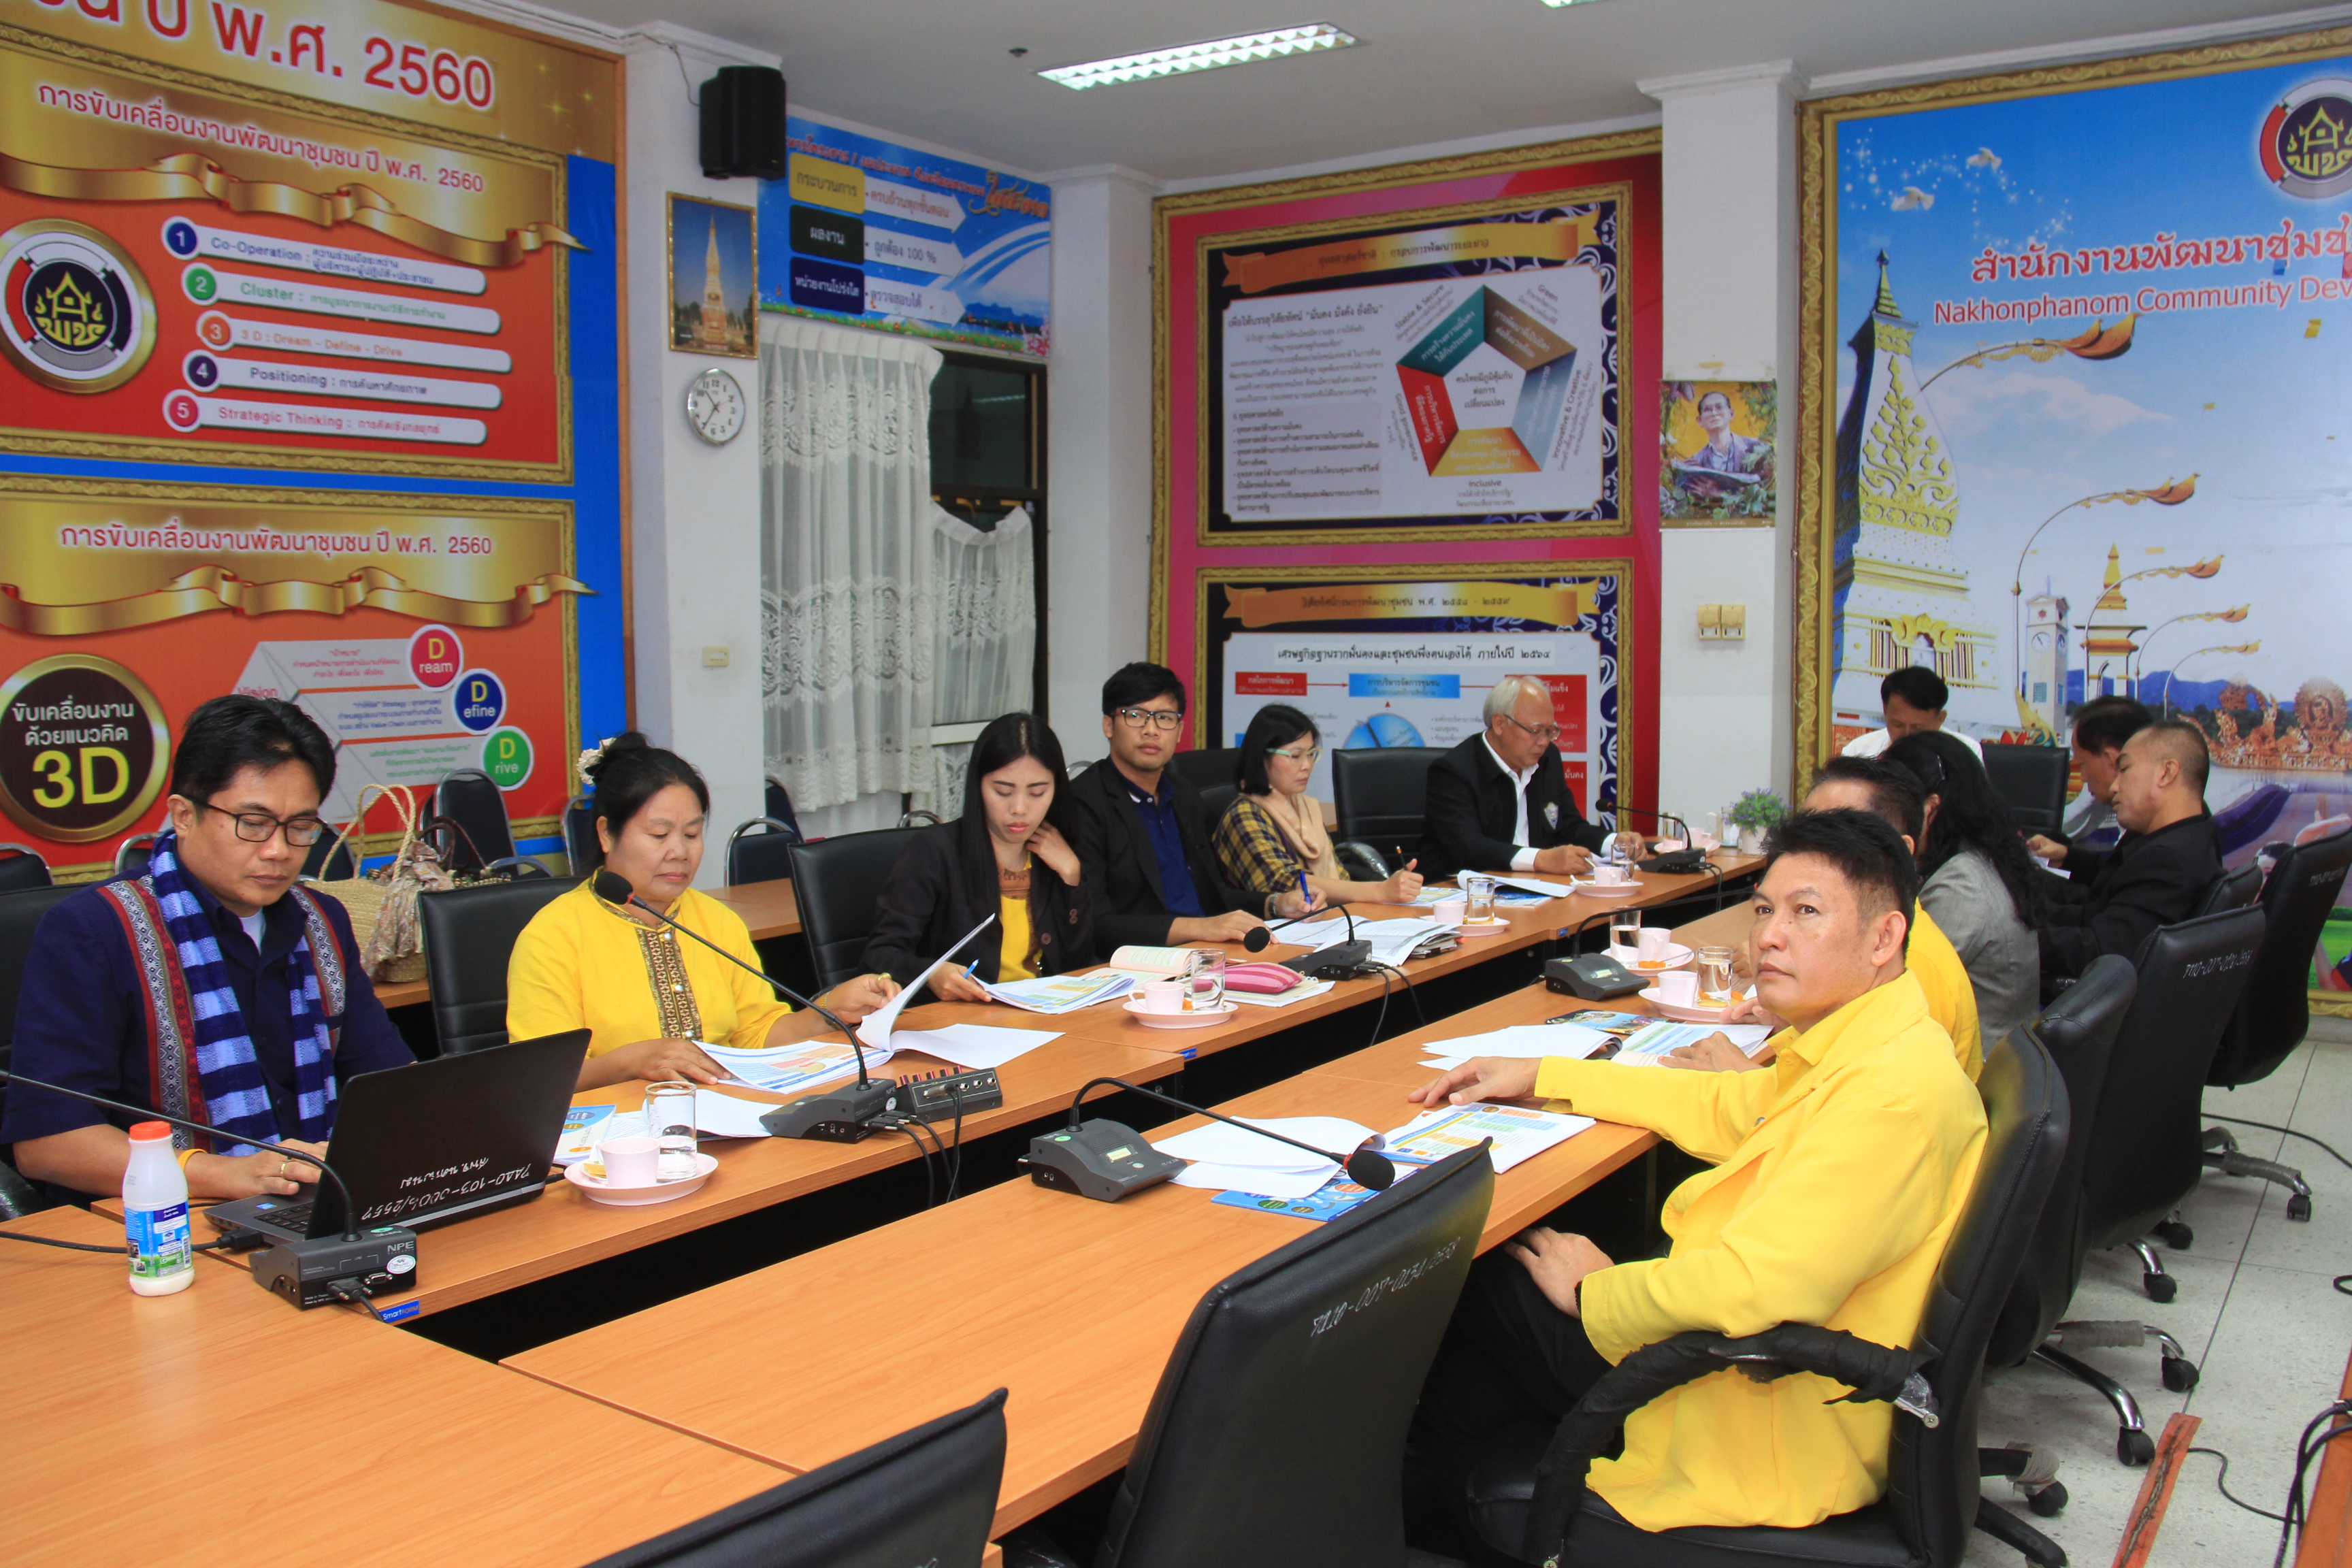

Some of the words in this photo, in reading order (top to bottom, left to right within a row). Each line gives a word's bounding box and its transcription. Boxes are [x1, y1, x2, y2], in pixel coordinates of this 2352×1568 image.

[212, 2, 343, 78] พ.ศ.
[364, 37, 491, 108] 2560
[39, 84, 361, 169] การขับเคลื่อนงานพัฒนาชุมชน
[367, 151, 380, 172] ปี
[385, 159, 427, 182] พ.ศ.
[438, 168, 483, 193] 2560
[796, 172, 858, 197] กระบวนการ
[178, 231, 185, 247] 1
[810, 227, 845, 246] ผลงาน
[211, 237, 302, 263] Co-Operation
[875, 236, 904, 258] ถูกต้อง
[907, 245, 924, 261] 100
[195, 276, 207, 293] 2
[240, 283, 293, 301] Cluster
[1935, 290, 2129, 324] Nakhonphanom
[2137, 280, 2292, 310] Community
[2300, 276, 2352, 301] Dev
[210, 323, 222, 340] 3
[242, 330, 249, 340] 3
[253, 331, 262, 342] D
[274, 332, 312, 347] Dream
[325, 339, 361, 353] Define
[374, 344, 403, 357] Drive
[197, 362, 208, 378] 4
[250, 367, 327, 389] Positioning
[177, 402, 190, 418] 5
[219, 406, 282, 423] Strategic
[287, 411, 344, 429] Thinking
[61, 518, 372, 558] การขับเคลื่อนงานพัฒนาชุมชน
[376, 531, 390, 553] ปี
[396, 534, 436, 555] พ.ศ.
[448, 535, 492, 555] 2560
[428, 638, 445, 659] D
[1477, 645, 1514, 659] ภายในปี
[419, 662, 453, 674] ream
[471, 681, 488, 702] D
[12, 695, 134, 723] ขับเคลื่อนงาน
[463, 704, 497, 718] efine
[24, 721, 129, 746] ด้วยแนวคิด
[499, 738, 515, 760] D
[32, 746, 130, 808] 3D
[494, 761, 519, 774] rive
[387, 1241, 414, 1253] NPE
[383, 1305, 419, 1321] SmartFORM
